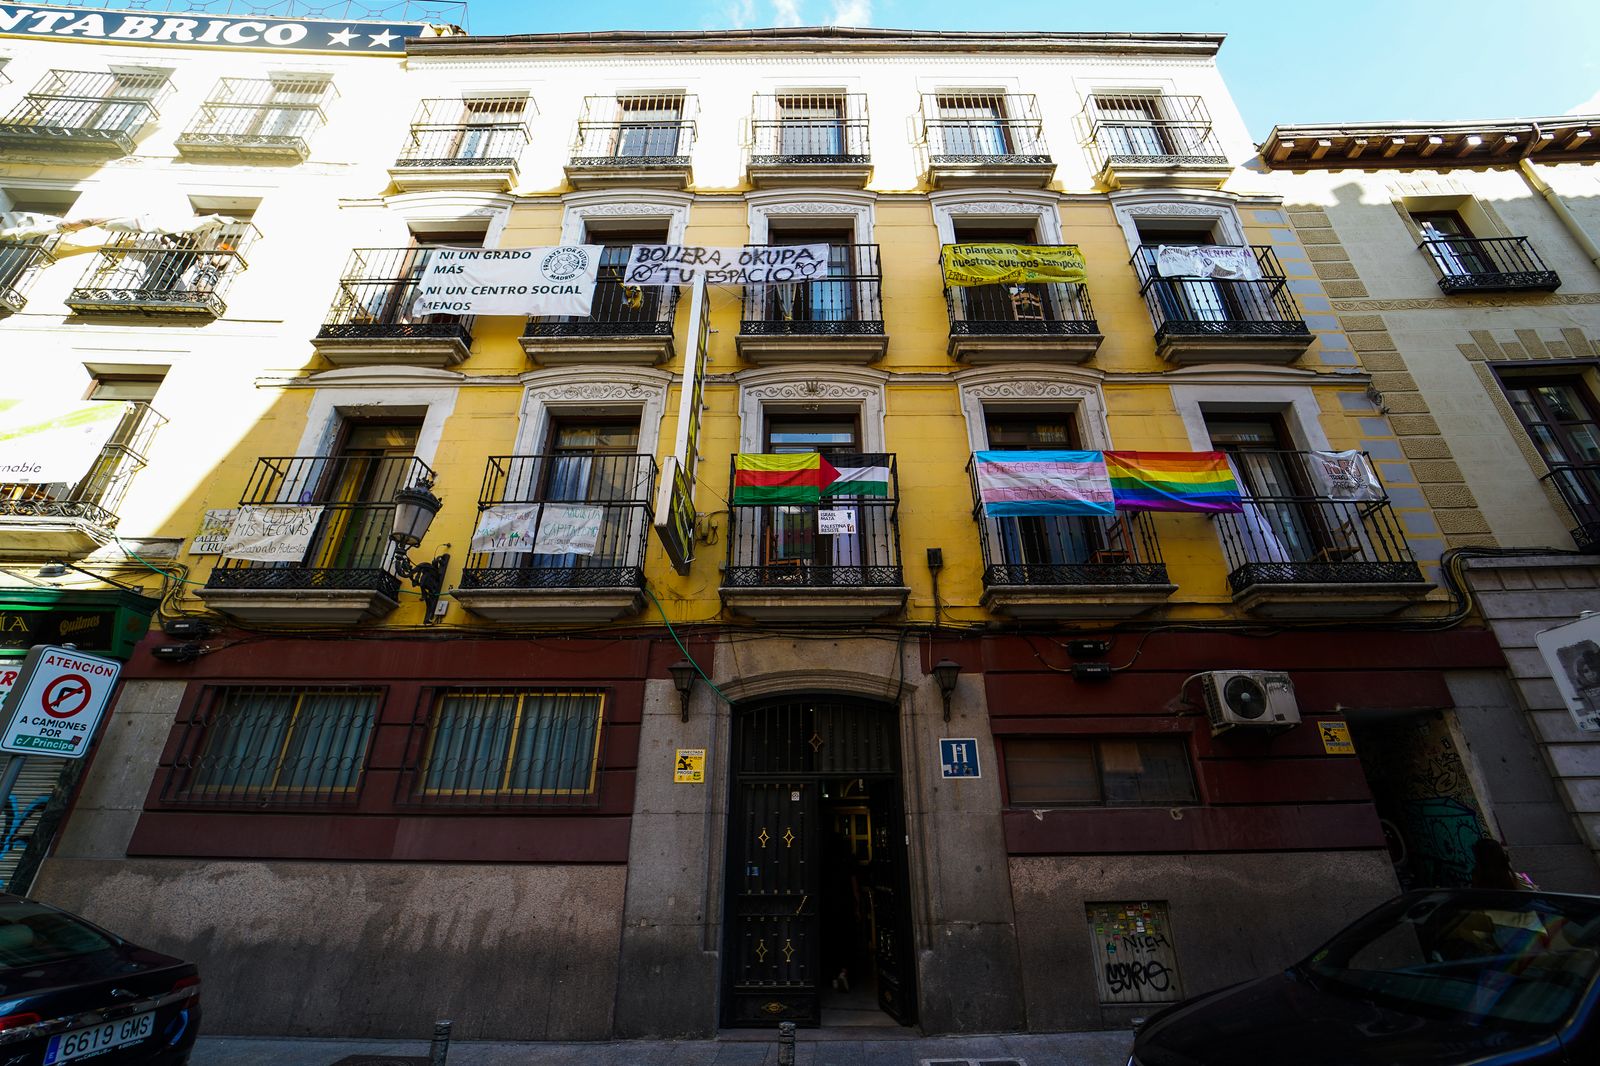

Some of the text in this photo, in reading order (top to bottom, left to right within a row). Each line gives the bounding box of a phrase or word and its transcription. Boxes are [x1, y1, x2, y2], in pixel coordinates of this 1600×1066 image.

[439, 251, 532, 260] NI UN GRADO
[739, 247, 815, 267] OKUPA
[952, 246, 963, 255] El
[966, 246, 1005, 257] planeta
[1006, 248, 1019, 256] no
[543, 250, 561, 271] FRIDAYS
[577, 250, 588, 271] FUTURE
[952, 257, 995, 268] nuestros
[1041, 258, 1084, 271] tampoco
[434, 264, 464, 274] MÁS
[549, 273, 576, 281] MADRID
[659, 266, 795, 284] TU ESPACIO
[426, 285, 582, 295] NI UN CENTRO SOCIAL
[422, 302, 472, 311] MENOS
[234, 522, 310, 537] MIS VECINAS
[201, 543, 223, 553] CRU
[45, 655, 114, 678] ATENCIÓN
[20, 715, 88, 732] A CAMIONES
[39, 728, 62, 738] POR
[16, 736, 31, 745] c/
[63, 1023, 115, 1057] 6619
[120, 1015, 150, 1041] GMS
